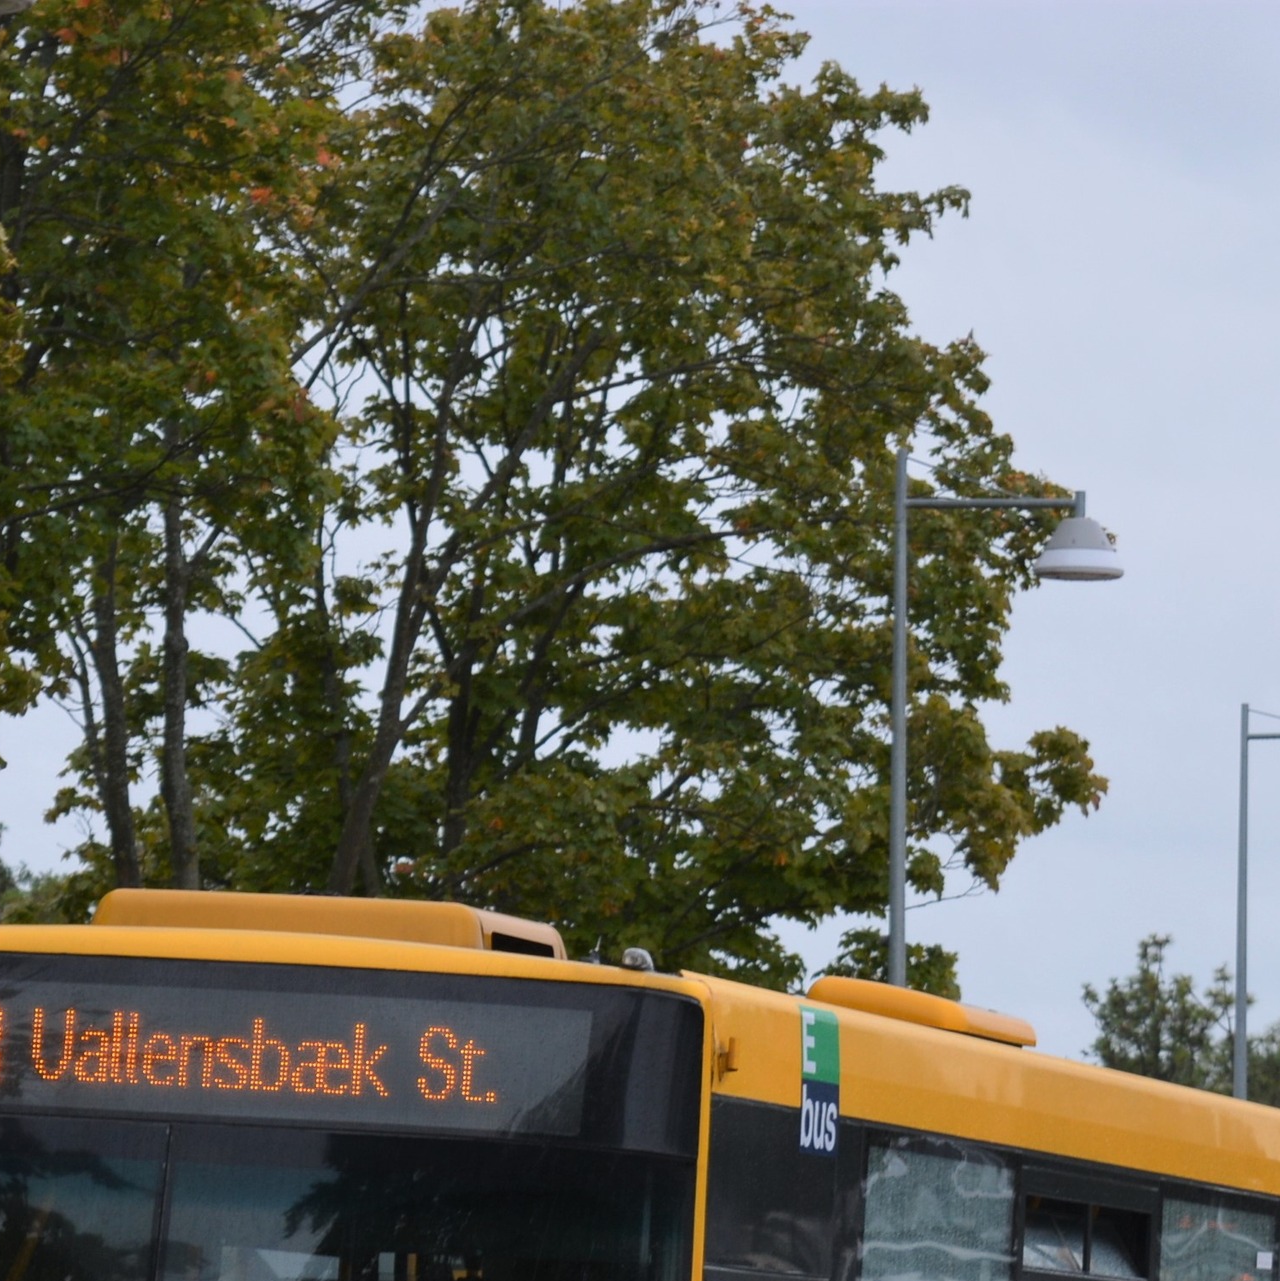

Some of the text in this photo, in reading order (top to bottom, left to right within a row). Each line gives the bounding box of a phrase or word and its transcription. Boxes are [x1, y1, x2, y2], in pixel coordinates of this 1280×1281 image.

[30, 1007, 388, 1098] Vallensbæk
[418, 1025, 497, 1102] St.
[801, 1011, 817, 1075] E
[800, 1084, 838, 1152] bus
